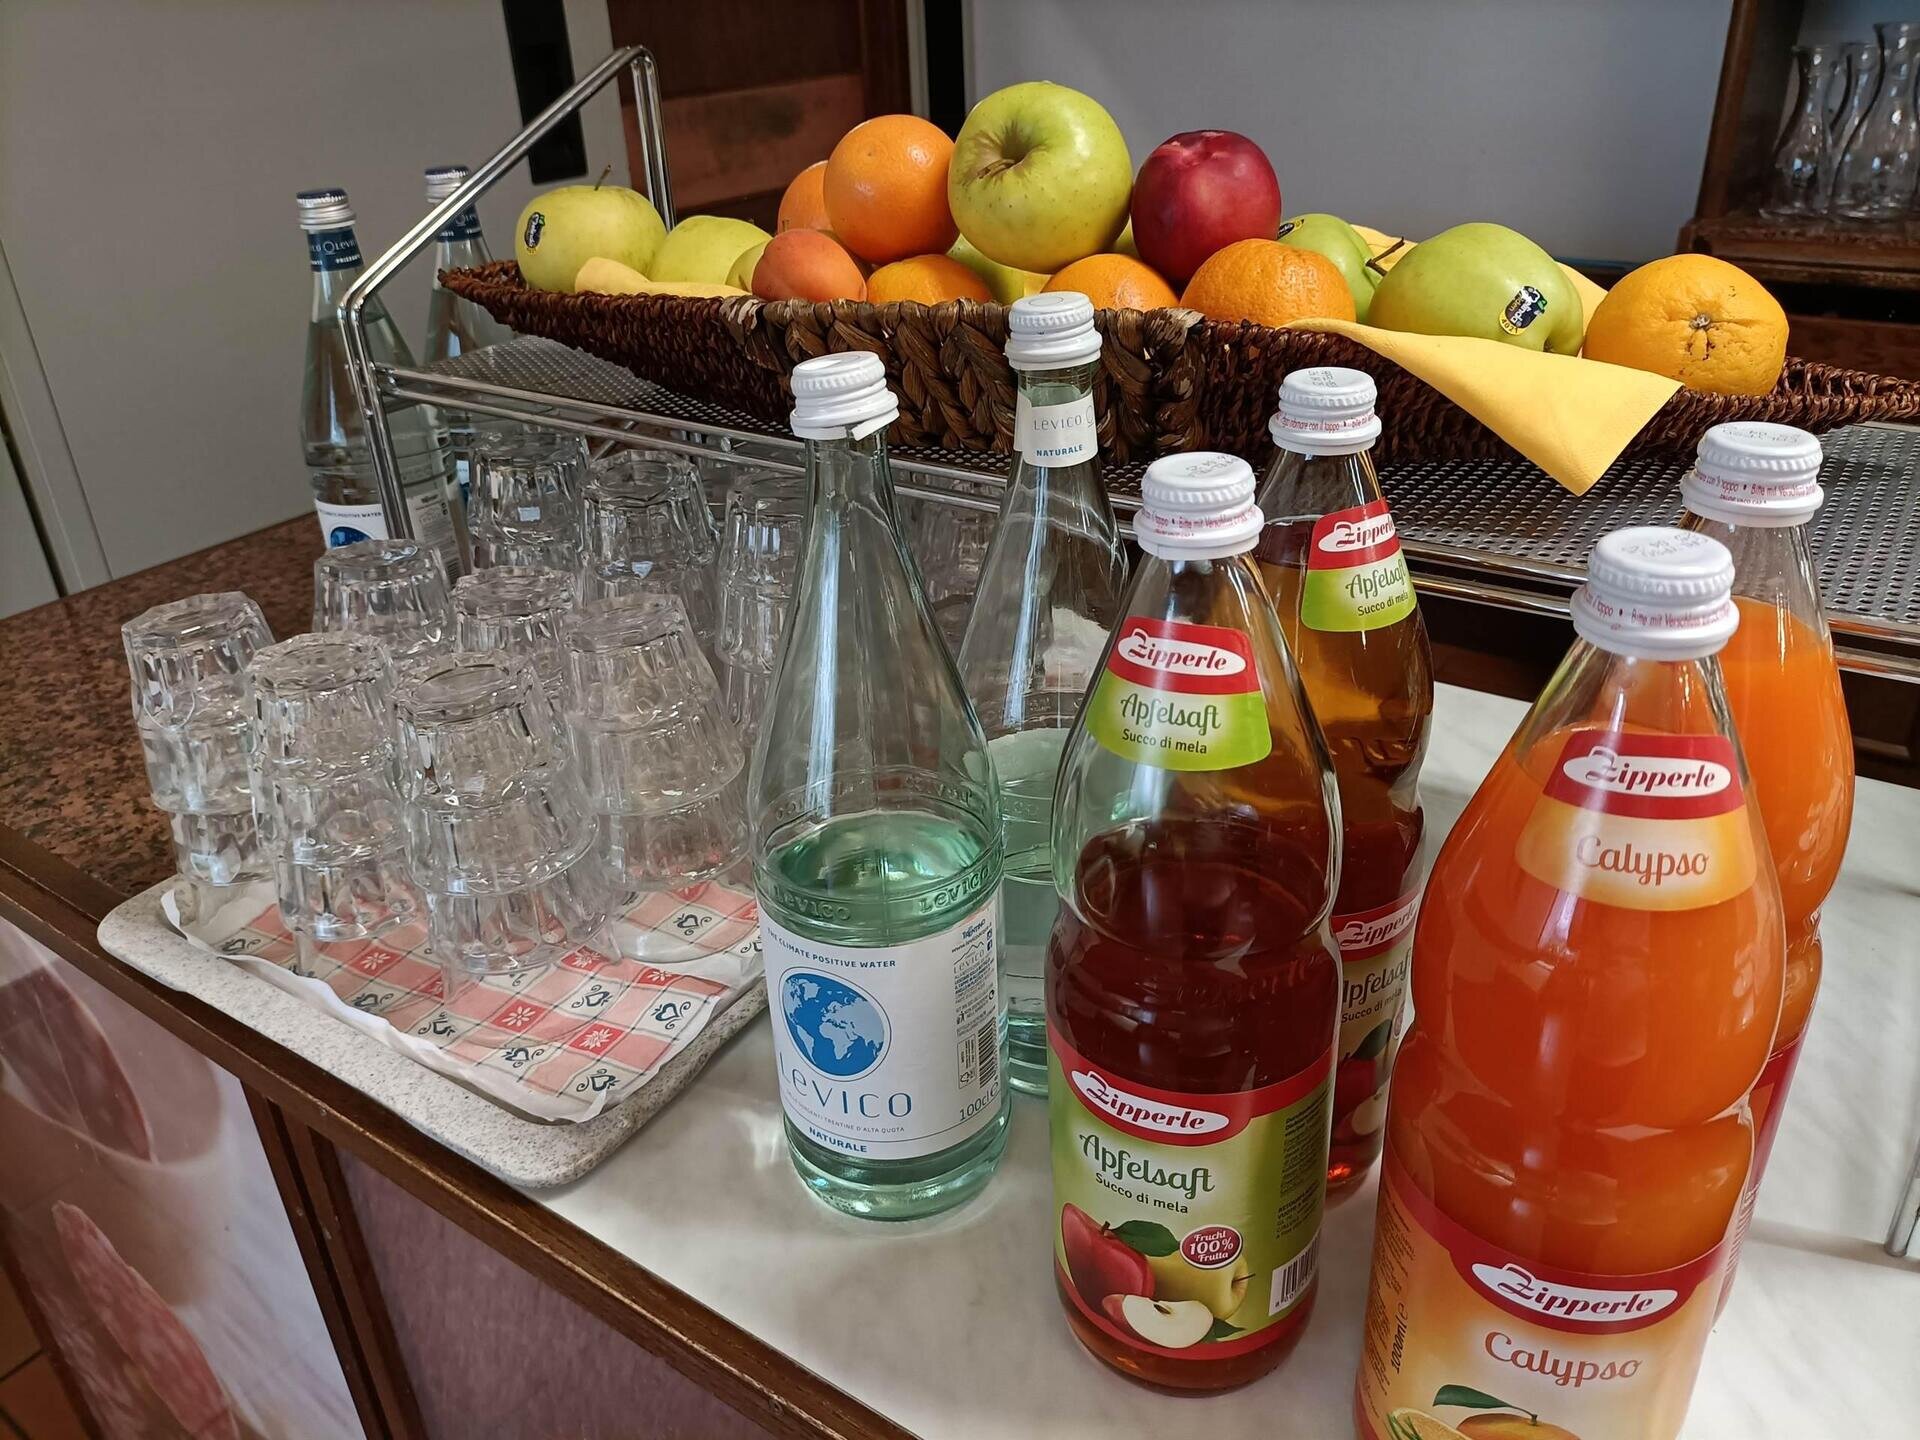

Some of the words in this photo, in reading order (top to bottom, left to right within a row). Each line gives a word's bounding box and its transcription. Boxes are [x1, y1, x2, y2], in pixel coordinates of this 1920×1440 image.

[1036, 444, 1083, 457] NATURALE
[1357, 604, 1385, 616] Succo
[1387, 597, 1395, 606] di
[1128, 631, 1227, 671] Zipperle
[1120, 693, 1222, 736] Apfelsaft
[1122, 728, 1157, 747] Succo
[1160, 737, 1172, 749] di
[1175, 740, 1208, 754] mela
[1585, 749, 1716, 792] Zipperle
[1577, 836, 1710, 886] Calypso
[778, 938, 810, 958] CLIMATE
[812, 953, 858, 968] POSITIVE
[860, 960, 896, 968] WATER
[1341, 1008, 1372, 1023] Succo
[1374, 1001, 1383, 1012] di
[960, 1090, 990, 1121] 100cl
[1086, 1074, 1205, 1129] Zipperle
[809, 1126, 868, 1152] NATURALE
[824, 1117, 854, 1131] TRENTINE
[1079, 1134, 1215, 1200] Apfelsaft
[1095, 1172, 1132, 1198] Succo
[1136, 1192, 1149, 1204] di
[1153, 1199, 1188, 1214] mela
[1190, 1237, 1234, 1255] 100%
[1194, 1230, 1227, 1242] Frucht
[1198, 1252, 1229, 1262] Frutta
[1497, 1267, 1653, 1315] Zipperle
[1390, 1313, 1407, 1375] 1000ml
[1485, 1331, 1643, 1388] Calypso
